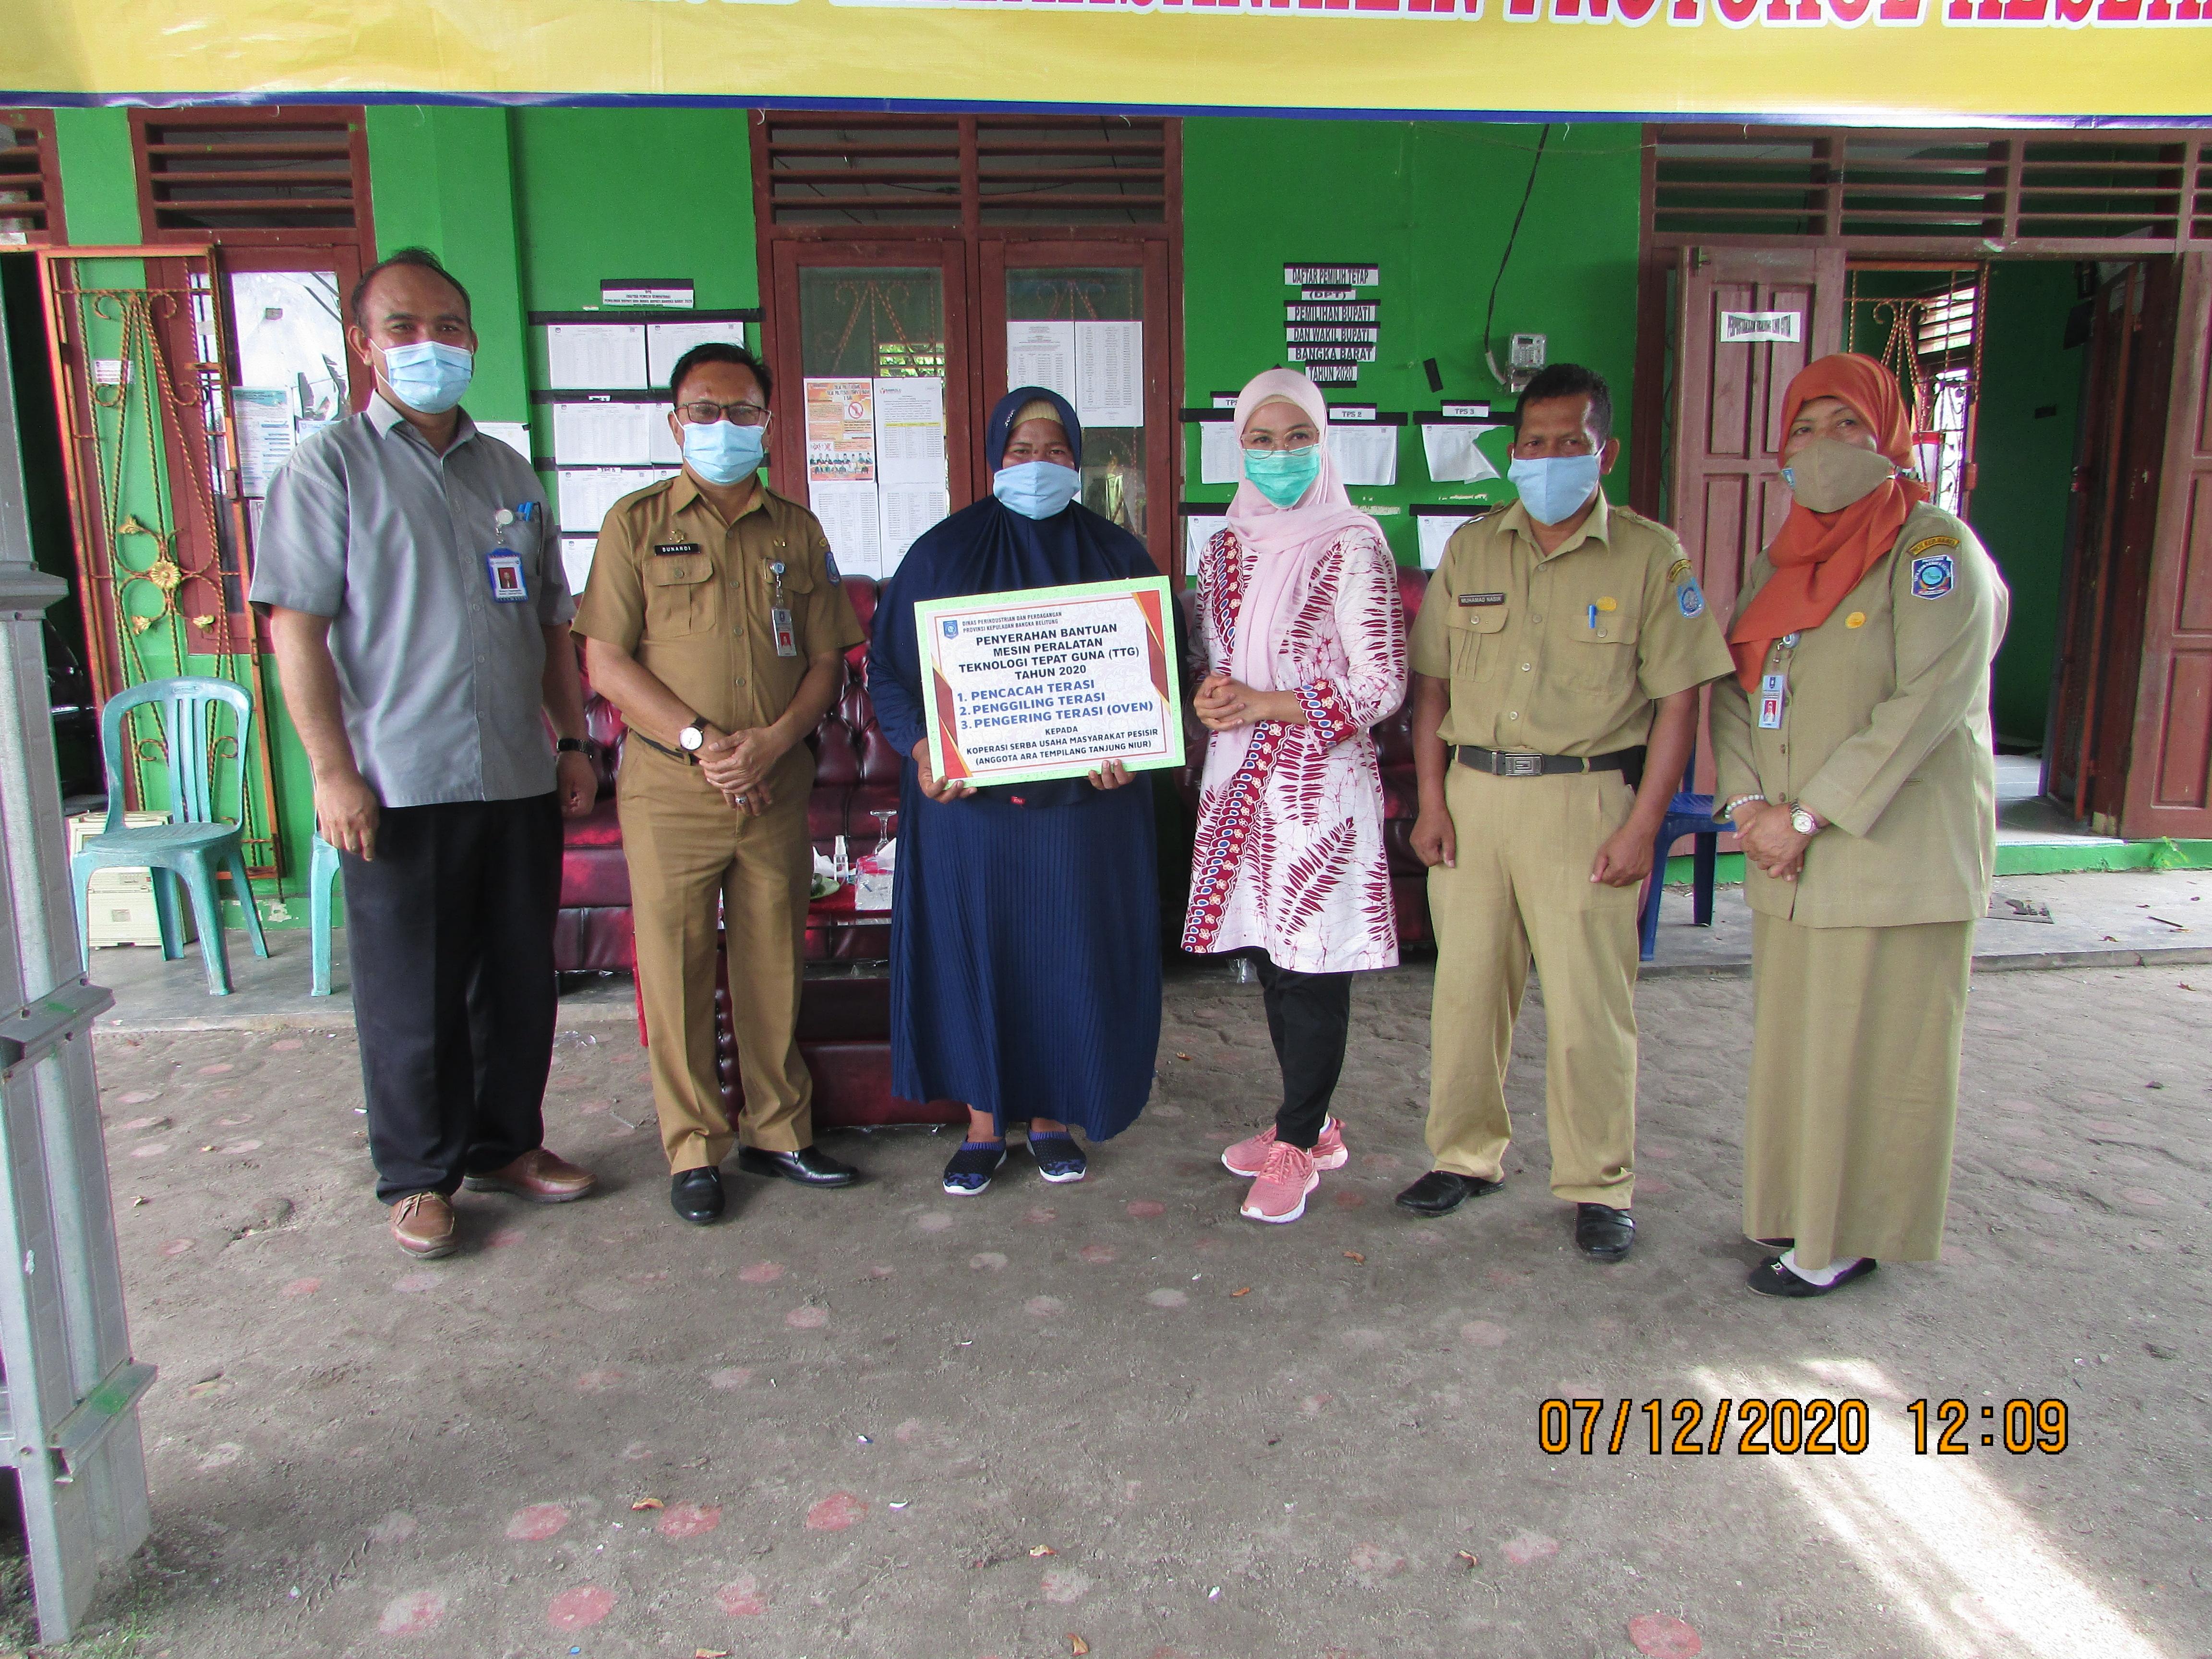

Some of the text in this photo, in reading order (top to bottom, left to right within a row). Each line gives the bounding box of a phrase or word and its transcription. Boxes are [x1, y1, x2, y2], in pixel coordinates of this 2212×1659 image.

[1292, 268, 1369, 284] DAFTAR PEMILIH TETAP
[1310, 291, 1346, 300] (DPT)
[1295, 306, 1370, 321] PEMILIHAN BUPATI
[1294, 328, 1369, 342] DAN WAKIL BUPATI
[1296, 348, 1372, 360] BANGKA BARAT
[1309, 366, 1353, 381] TAHUN 2020
[978, 616, 1015, 625] PERINDUSTRIAN
[1027, 612, 1062, 620] PERDAGANGAN
[976, 624, 1118, 646] PENYERAHAN BANTUAN
[987, 623, 1014, 631] KEPULAUAN
[993, 637, 1103, 657] MESIN PERALATAN
[958, 646, 1140, 673] TEKNOLOGI TEPAT GUNA (TTG)
[1015, 664, 1086, 680] TAHUN 2020
[957, 679, 1095, 702] 1. PENCACAH TERASI
[960, 692, 1106, 716] 2. PENGGILING TERASI
[961, 700, 1153, 730] 3. PENGERING TERASI (OVEN)
[1045, 726, 1078, 735] KEPADA
[966, 729, 1158, 755] KOPERASI SERBA USAHA MASYARAKAT PESISIR
[975, 740, 1152, 766] (ANGGOTA ARA TEMPILANG TANJUNG NIUR)
